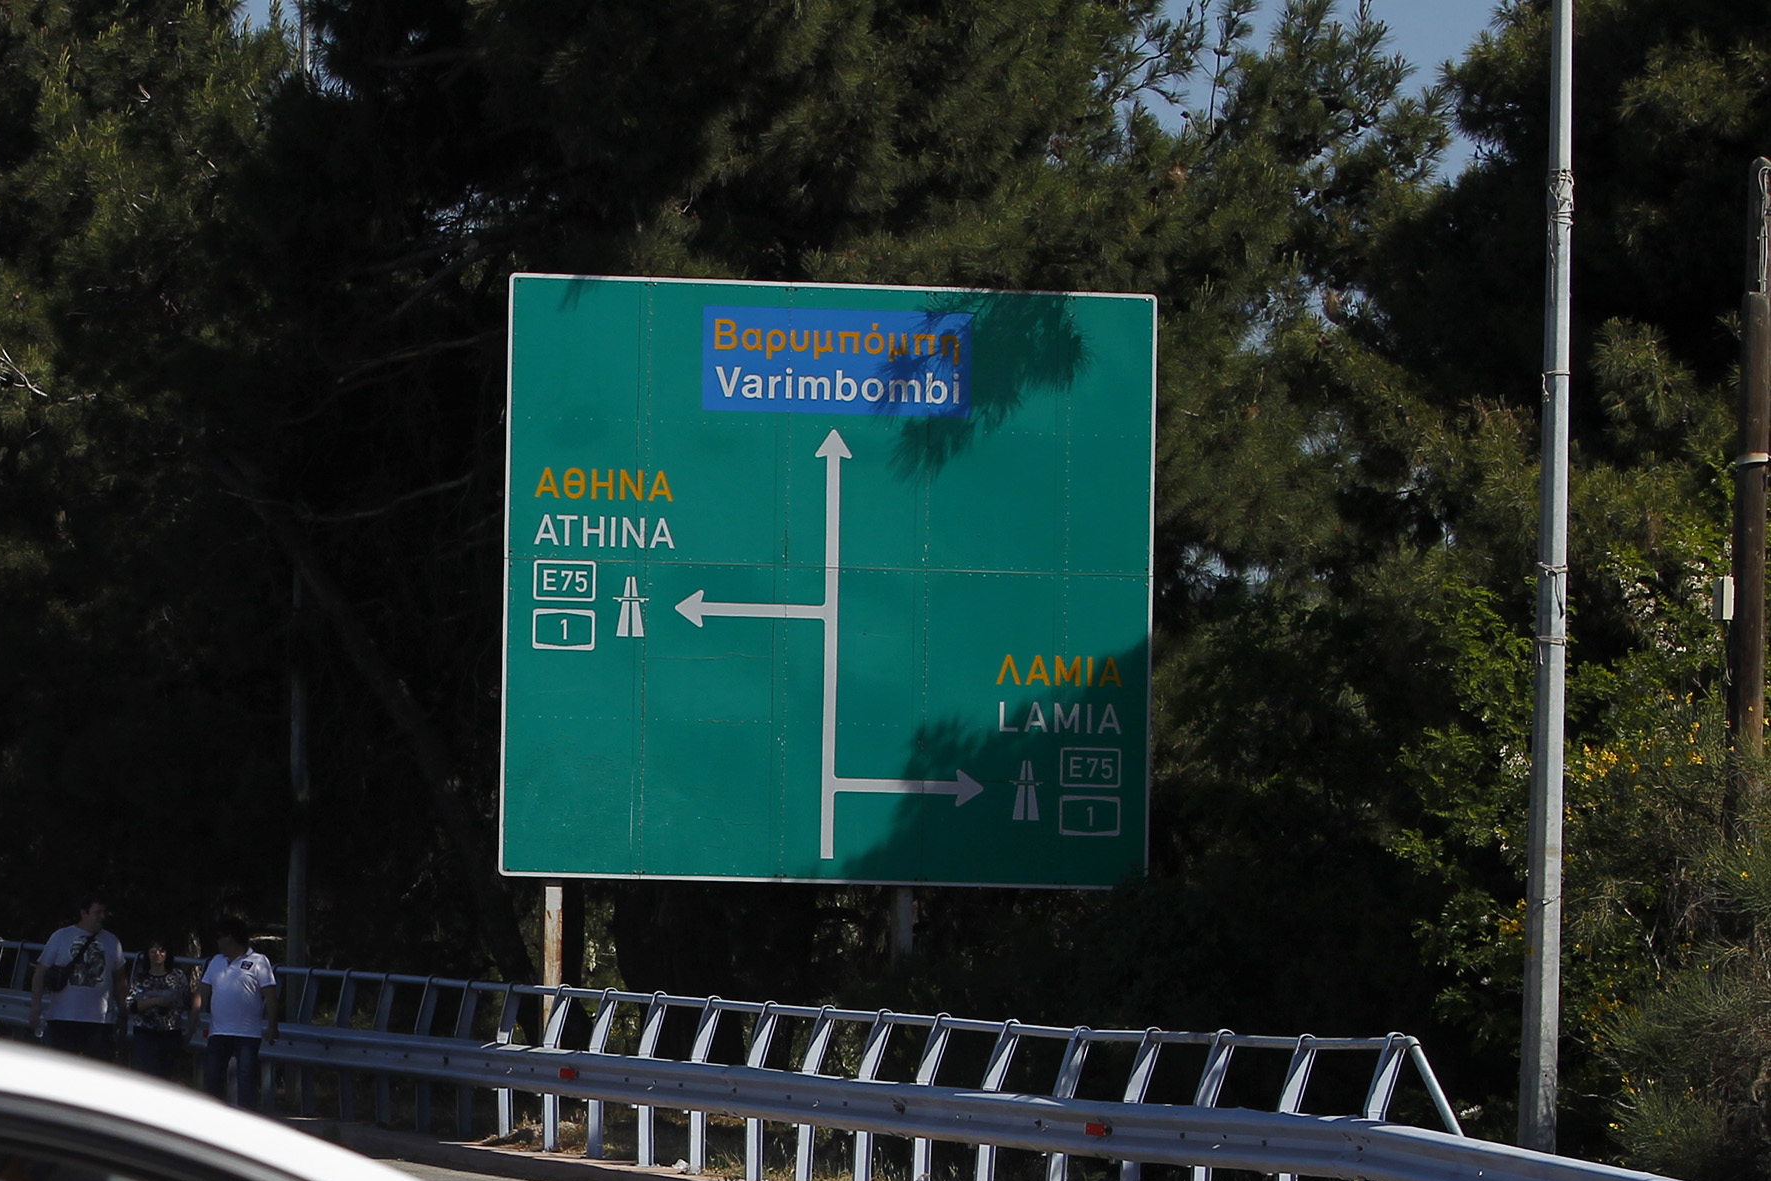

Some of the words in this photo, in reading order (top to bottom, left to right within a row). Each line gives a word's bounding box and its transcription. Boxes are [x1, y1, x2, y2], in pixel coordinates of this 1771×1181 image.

[714, 318, 960, 366] Βαρυμπόμπη
[715, 365, 960, 405] Varimbombi
[534, 466, 674, 502] ΑΘΗΝΑ
[534, 513, 676, 549] ATHINA
[542, 569, 589, 593] E75
[559, 617, 569, 641] 1
[995, 654, 1123, 688] ΛΑΜΙΑ
[998, 701, 1122, 735] LAMIA
[1069, 756, 1114, 780] E75
[1086, 806, 1095, 828] 1
